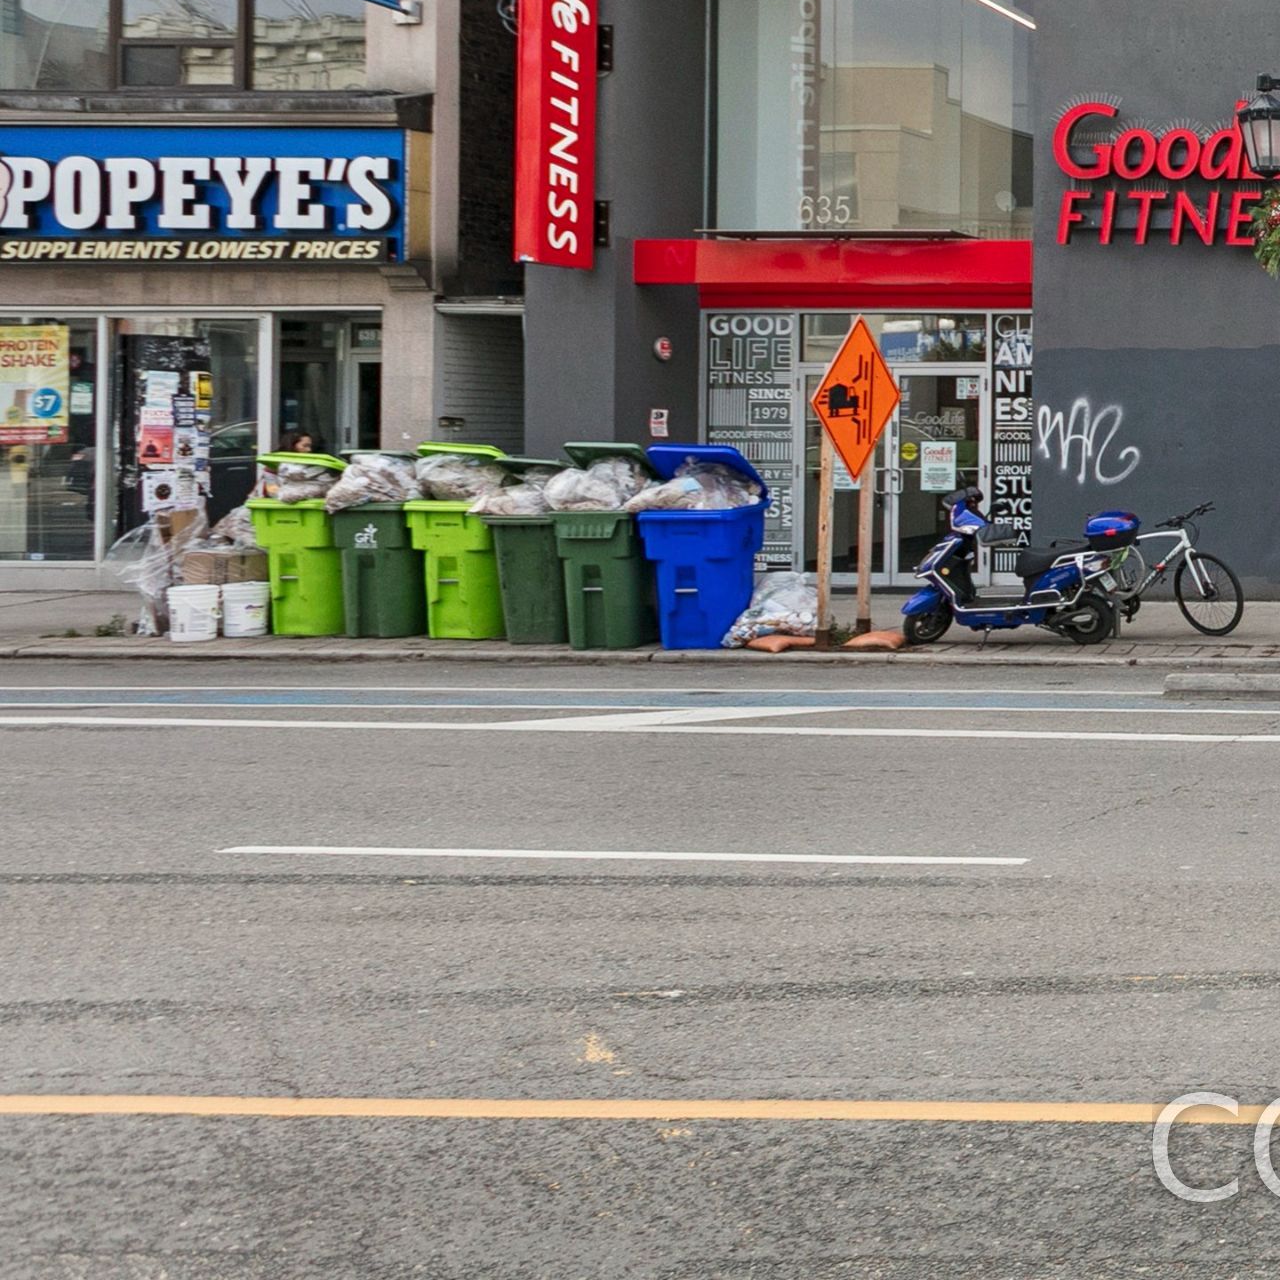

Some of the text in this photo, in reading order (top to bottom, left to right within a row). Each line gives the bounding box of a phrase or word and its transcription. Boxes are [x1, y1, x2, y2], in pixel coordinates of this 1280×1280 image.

[548, 40, 579, 255] FITNESS
[3, 155, 392, 230] POPEYE'S
[799, 195, 850, 224] 635
[1, 240, 382, 260] SUPPLEMENTS LOWEST PRICES
[709, 315, 793, 336] GOOD
[0, 340, 59, 352] PROTEIN
[710, 337, 793, 370] LIFE
[1, 353, 57, 368] SHAKE
[709, 371, 773, 384] FITNESS
[34, 394, 58, 412] $7
[748, 388, 792, 400] SINCE
[753, 406, 788, 420] 1979
[782, 487, 792, 527] TEAM
